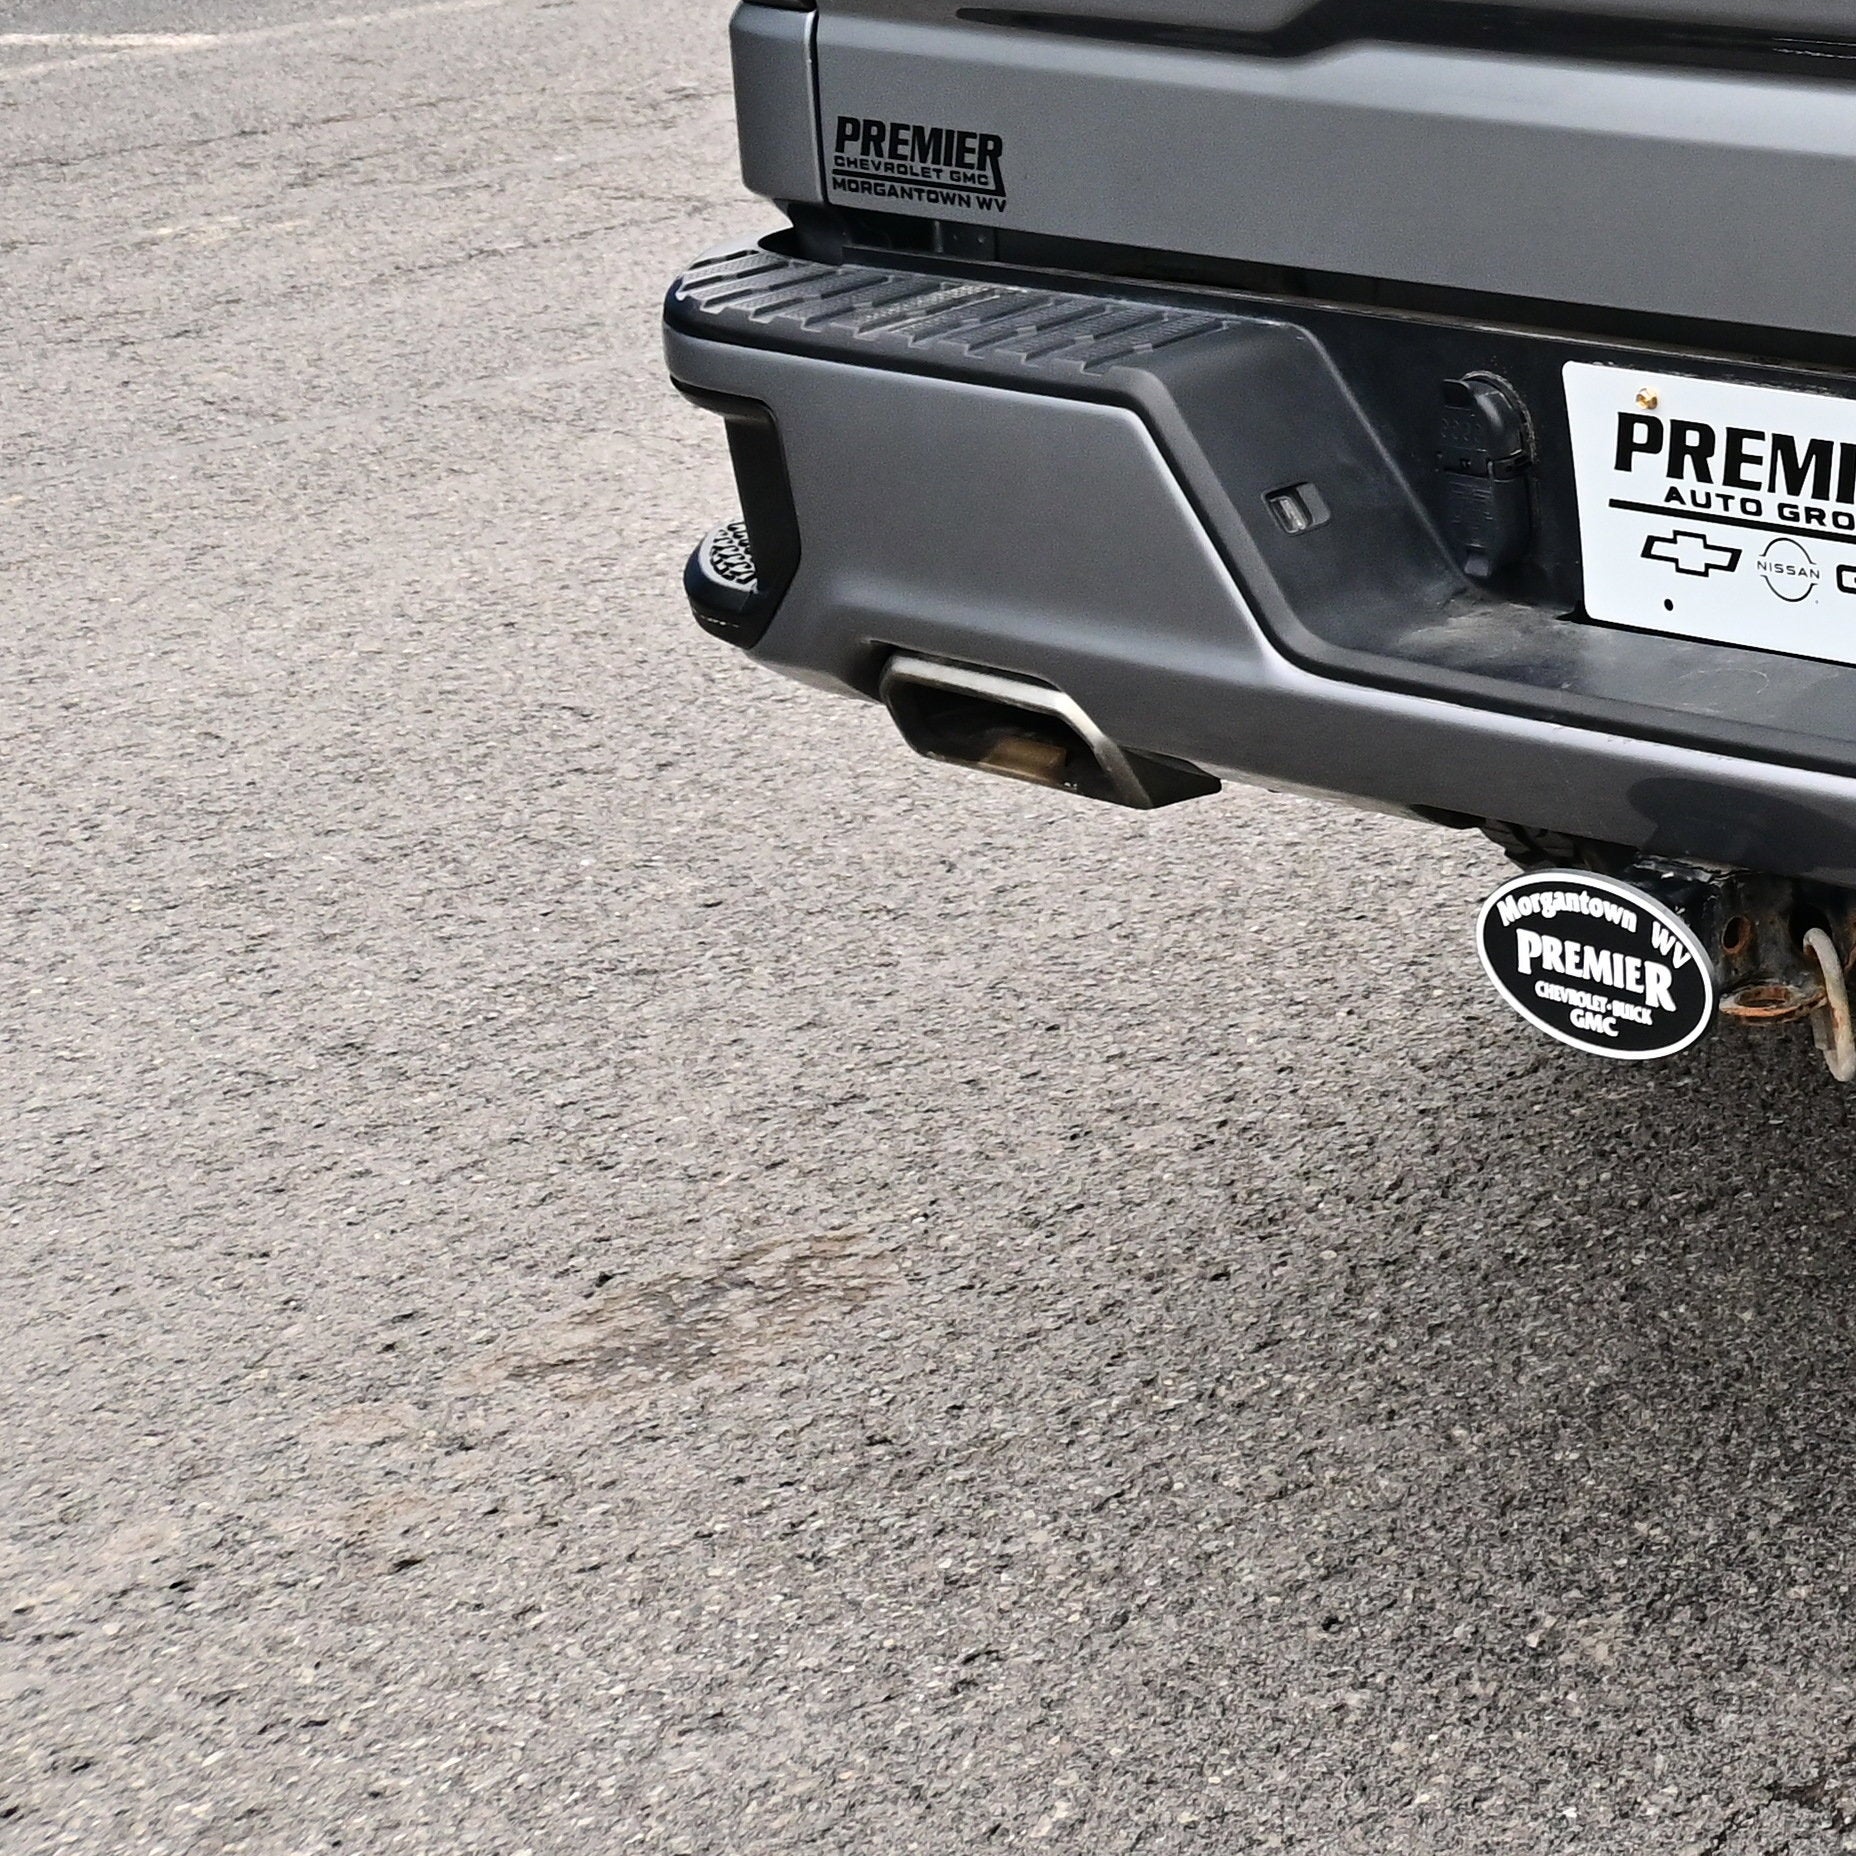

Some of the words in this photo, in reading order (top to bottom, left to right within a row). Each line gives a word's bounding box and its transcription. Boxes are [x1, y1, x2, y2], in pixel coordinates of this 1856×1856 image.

[833, 155, 943, 180] CHEVROLET
[949, 170, 989, 186] GMC
[835, 115, 1006, 196] PREMIER
[832, 176, 971, 209] MORGANTOWN
[976, 196, 1007, 212] WV
[1664, 486, 1764, 517] AUTO
[1756, 559, 1821, 580] NISSAN
[1496, 889, 1638, 933] Morgantown
[1651, 920, 1692, 970] WV
[1515, 928, 1677, 1012] PREMIER
[1570, 1008, 1619, 1037] GMC
